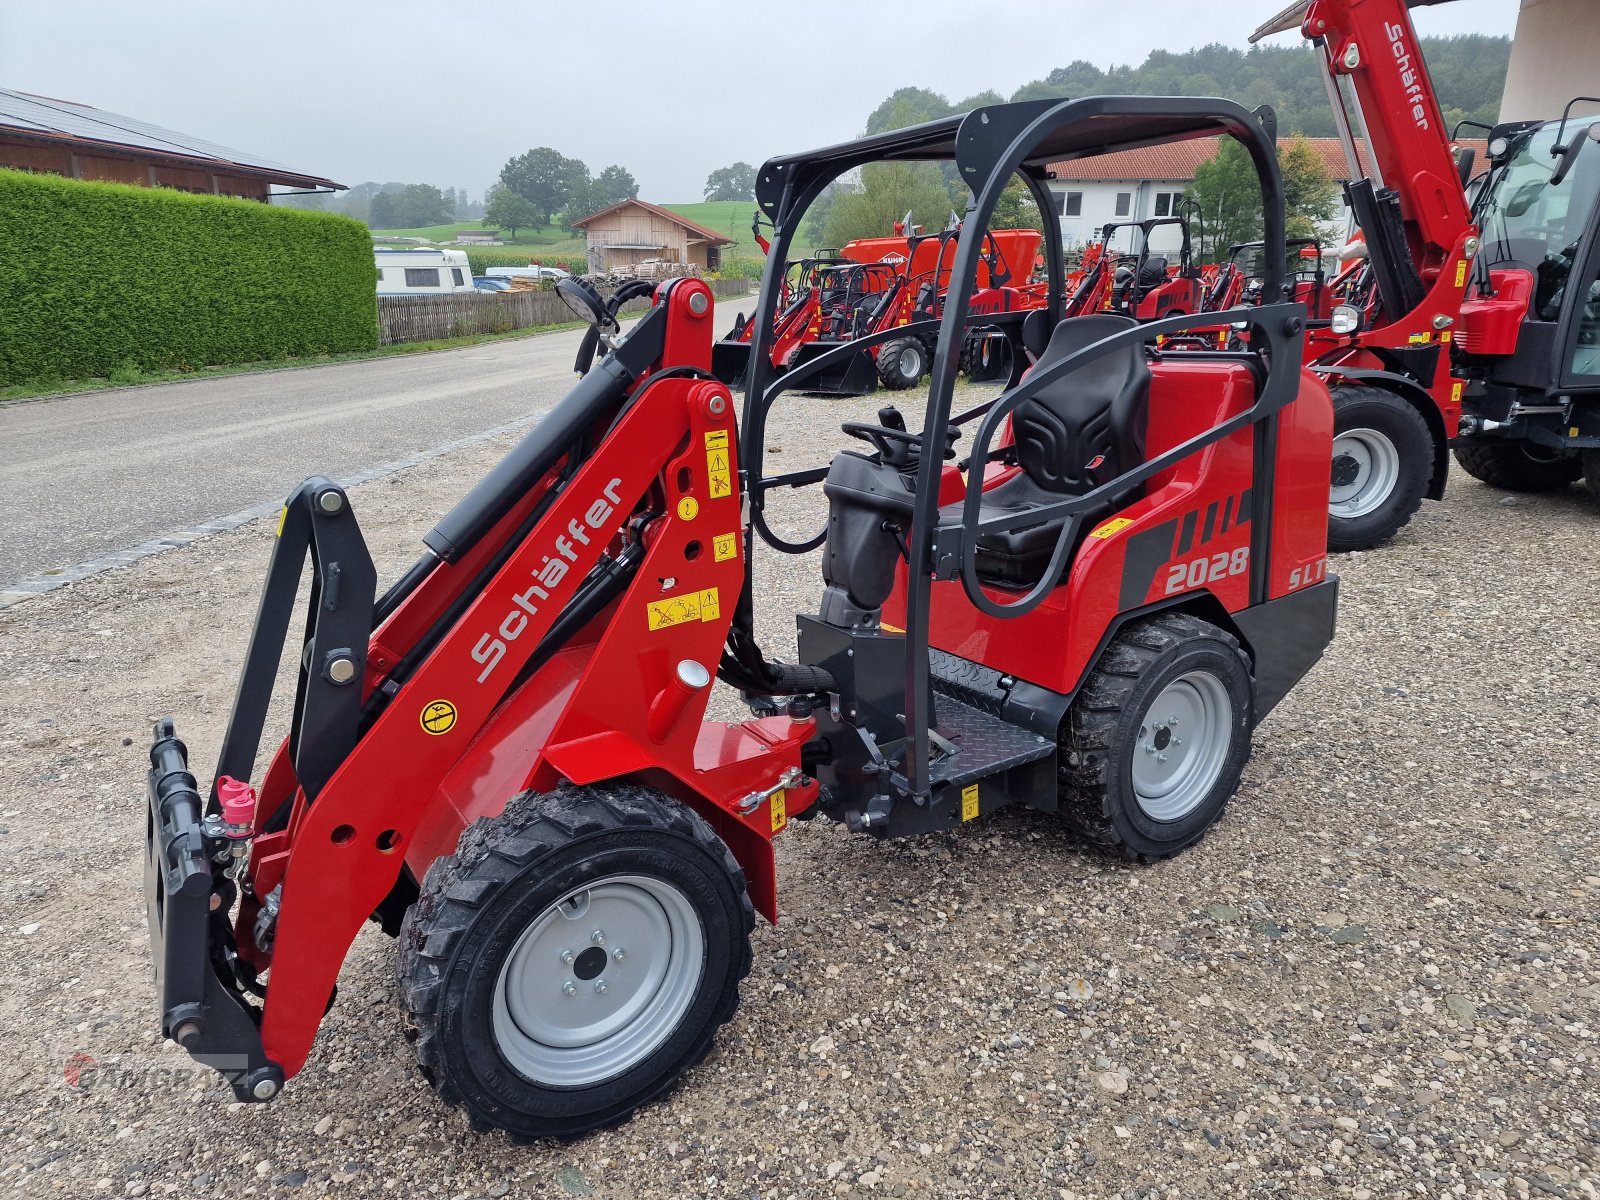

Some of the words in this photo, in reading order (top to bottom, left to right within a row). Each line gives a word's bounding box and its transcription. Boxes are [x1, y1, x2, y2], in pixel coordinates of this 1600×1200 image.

[1384, 21, 1429, 131] Schäffer
[882, 256, 904, 264] KUHN
[470, 477, 623, 684] Schäffer
[1165, 546, 1250, 595] 2028
[1287, 558, 1326, 591] SLT
